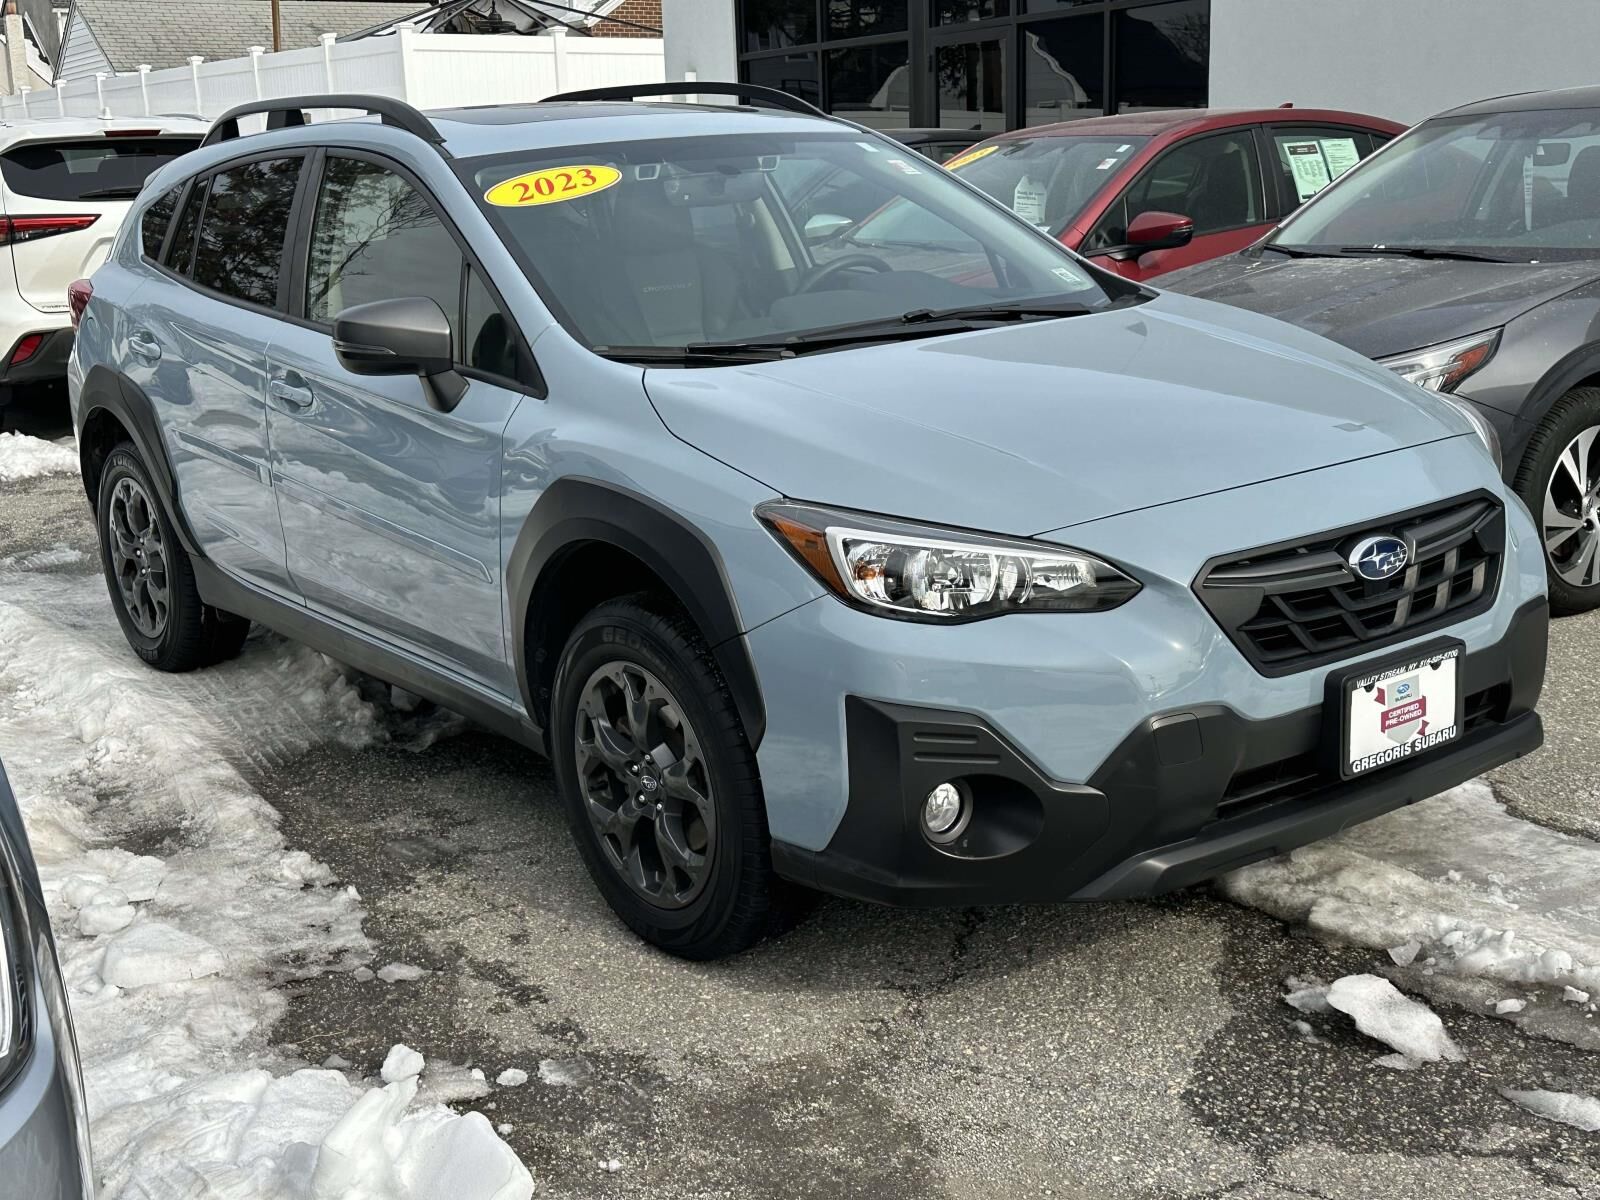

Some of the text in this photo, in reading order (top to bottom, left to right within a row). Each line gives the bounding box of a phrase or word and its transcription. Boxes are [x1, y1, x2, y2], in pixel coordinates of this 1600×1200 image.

[512, 168, 598, 203] 2023
[1356, 674, 1380, 688] VALLEY
[1407, 662, 1418, 672] NY
[1395, 693, 1413, 702] SUBARU
[1385, 709, 1423, 727] PRE-OWNED
[1388, 702, 1420, 719] CERTIFIED
[1352, 725, 1457, 773] GREGORIS SUBARU
